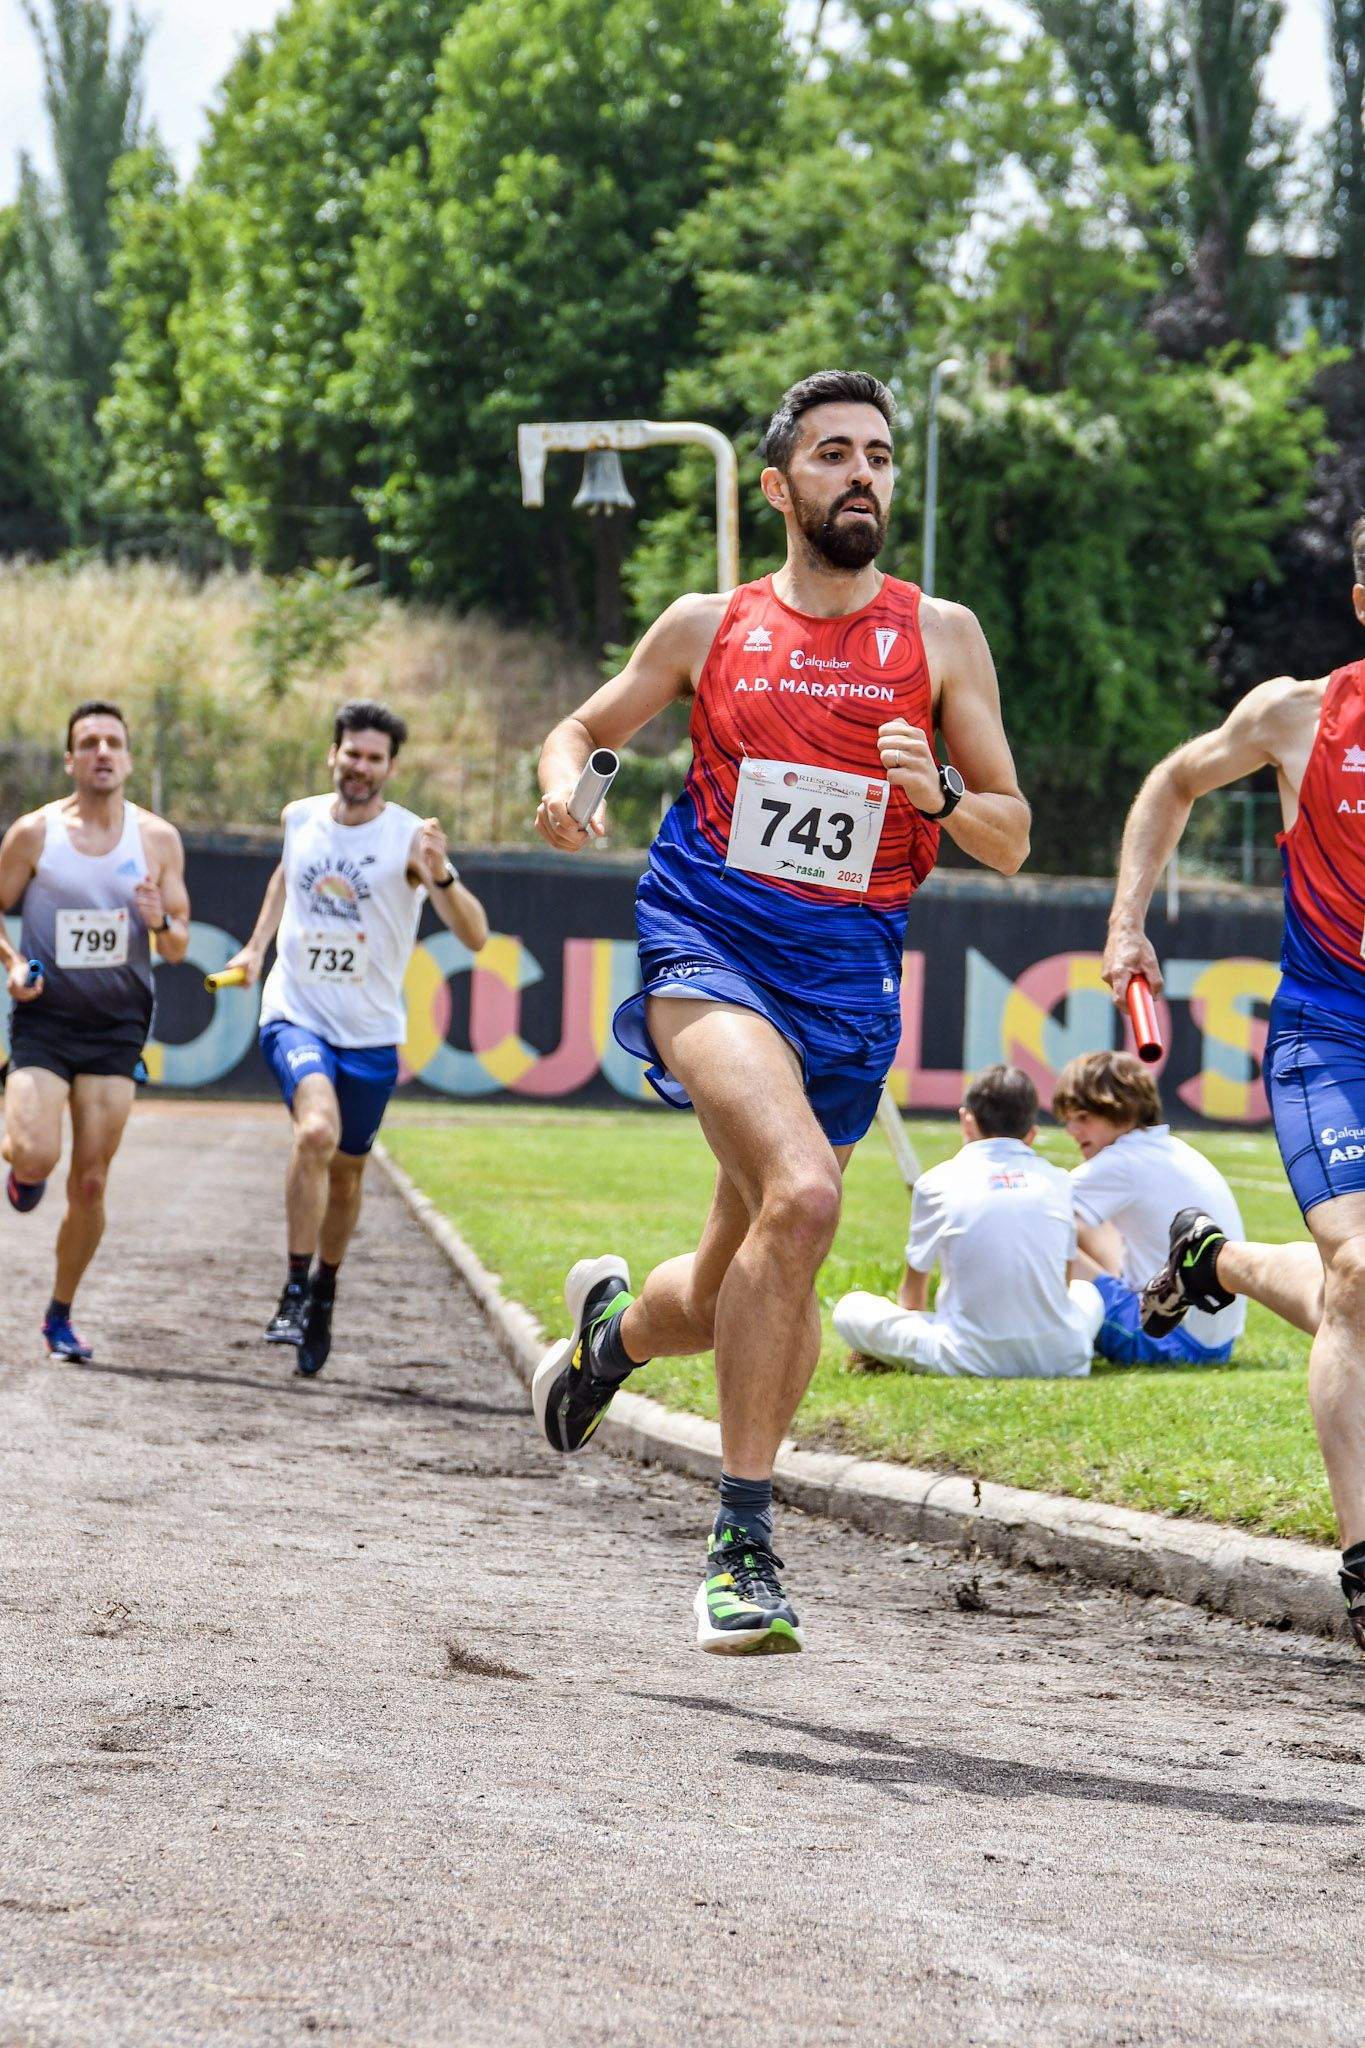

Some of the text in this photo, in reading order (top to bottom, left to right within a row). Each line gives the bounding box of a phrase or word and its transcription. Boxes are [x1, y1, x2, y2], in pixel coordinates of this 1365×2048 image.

[734, 678, 895, 702] A.D. MARATHON
[760, 797, 855, 861] 743
[796, 865, 863, 884] rasán 2023
[70, 929, 117, 953] 799
[307, 947, 354, 972] 732
